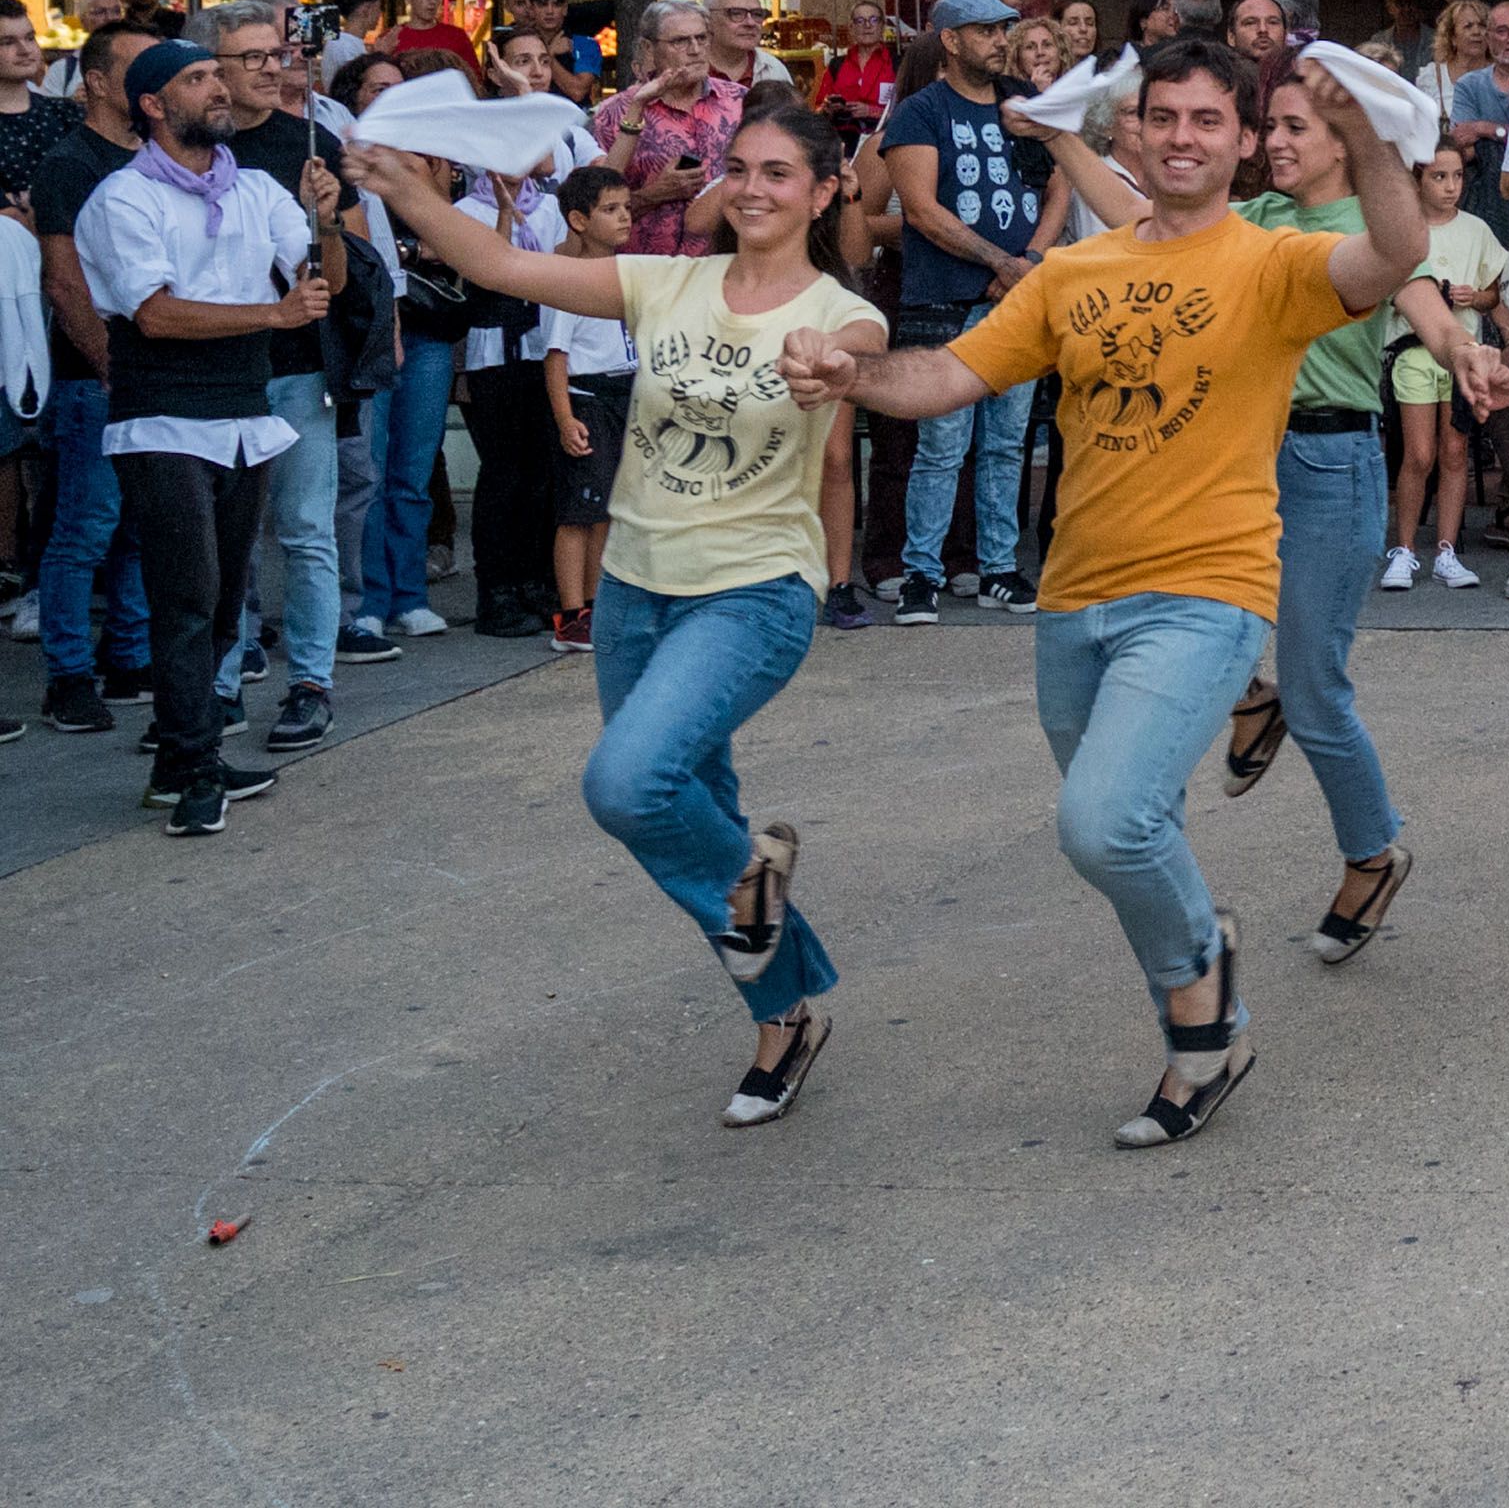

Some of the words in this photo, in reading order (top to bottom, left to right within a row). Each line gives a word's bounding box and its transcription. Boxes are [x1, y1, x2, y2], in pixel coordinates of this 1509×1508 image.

[1120, 281, 1173, 303] 100
[700, 335, 751, 368] 100
[1158, 365, 1213, 442] ESBART
[726, 427, 786, 490] ESBART
